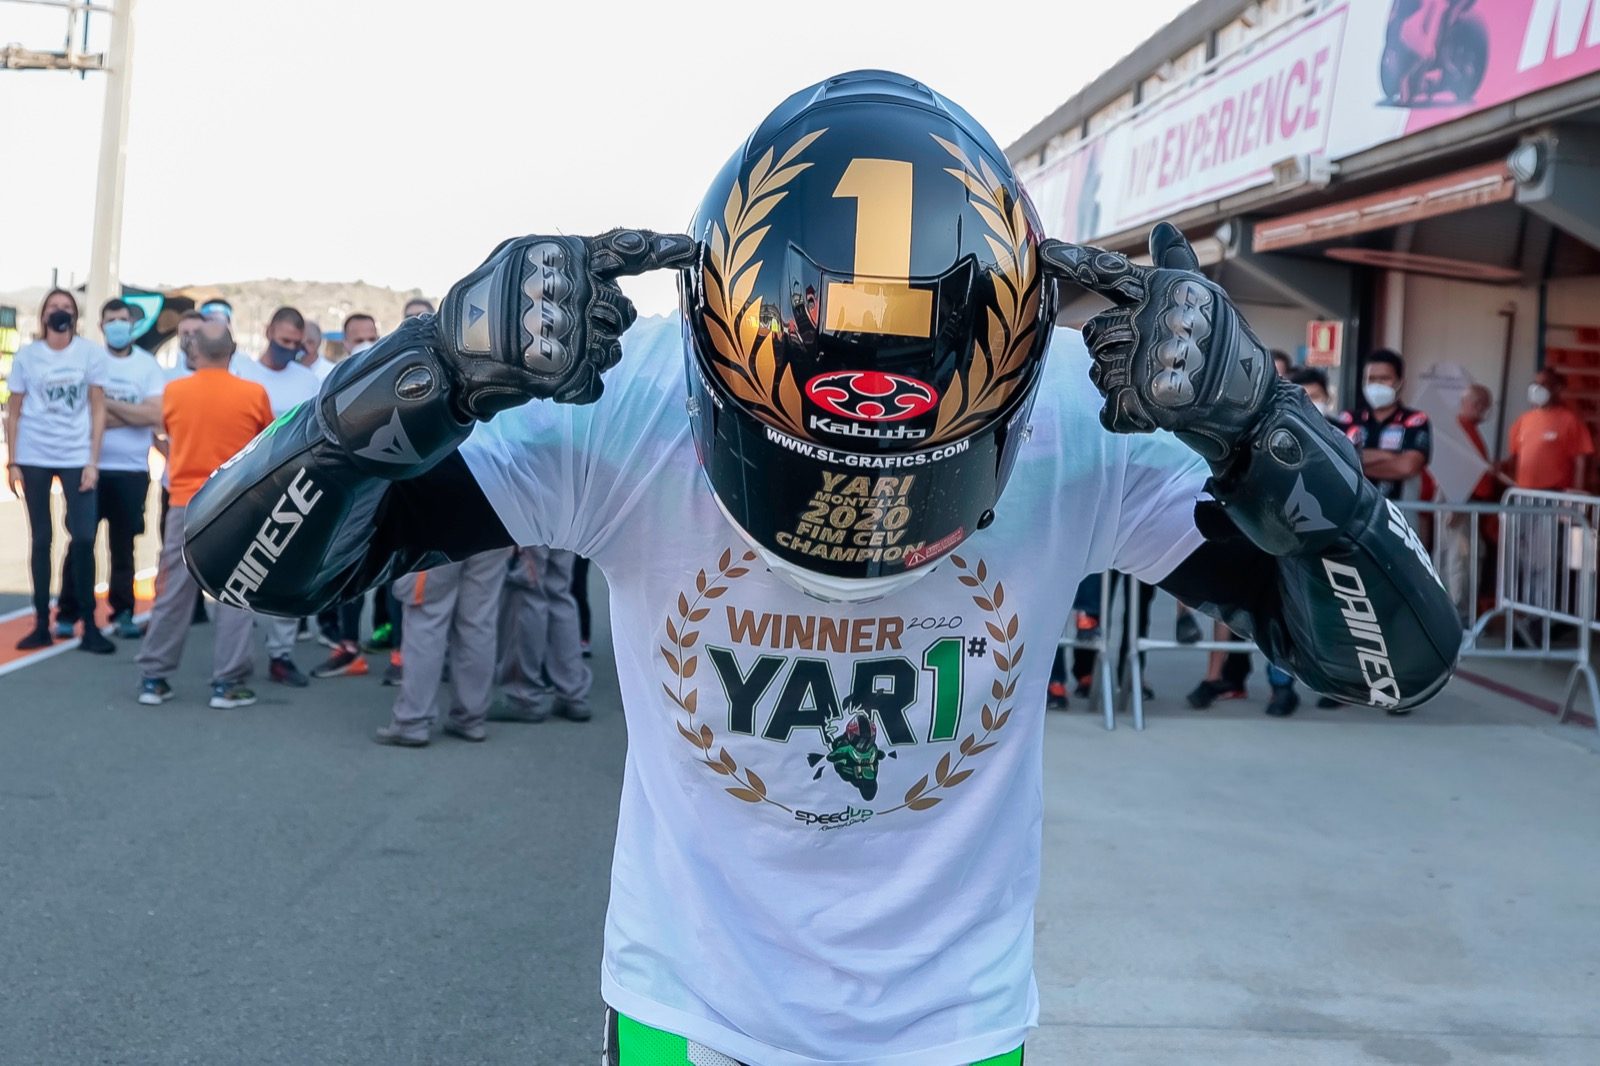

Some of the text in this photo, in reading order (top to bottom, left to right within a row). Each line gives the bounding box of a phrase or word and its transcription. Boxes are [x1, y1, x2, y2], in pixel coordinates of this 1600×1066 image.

[1158, 47, 1330, 188] EXPERIENCE
[825, 158, 934, 338] 1
[810, 415, 926, 439] Kabuto
[766, 429, 970, 468] WWW.SL-GRAFICS.COM
[821, 470, 916, 497] YARI
[800, 500, 912, 530] 2020
[775, 531, 927, 563] CHAMPION
[796, 521, 847, 544] FIM
[852, 529, 906, 547] CEV
[725, 605, 963, 654] WINNER 2020
